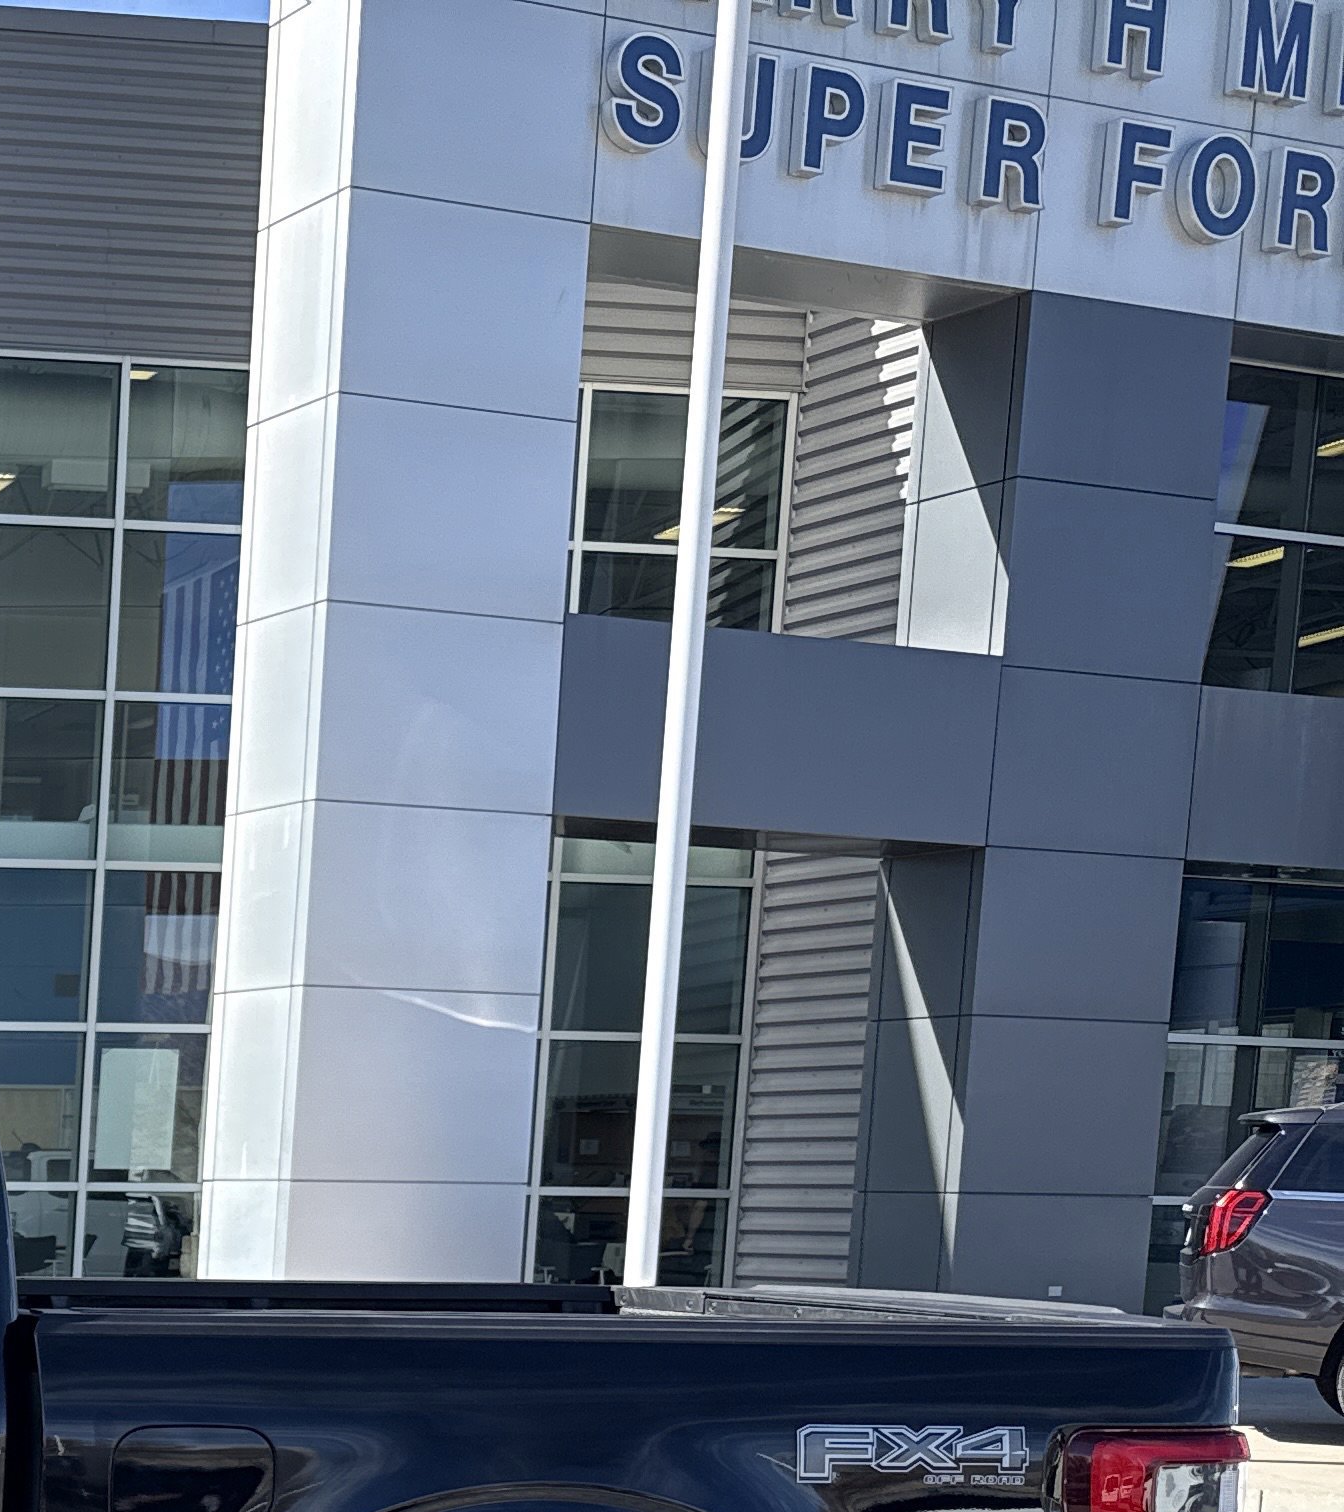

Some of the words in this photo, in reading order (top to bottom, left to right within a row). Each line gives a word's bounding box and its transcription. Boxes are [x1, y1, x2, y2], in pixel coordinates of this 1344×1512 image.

[1225, 0, 1344, 115] M
[602, 31, 1048, 213] SUPER
[796, 1424, 1030, 1484] FX4
[923, 1474, 965, 1485] OFF
[970, 1475, 1026, 1486] ROAD
